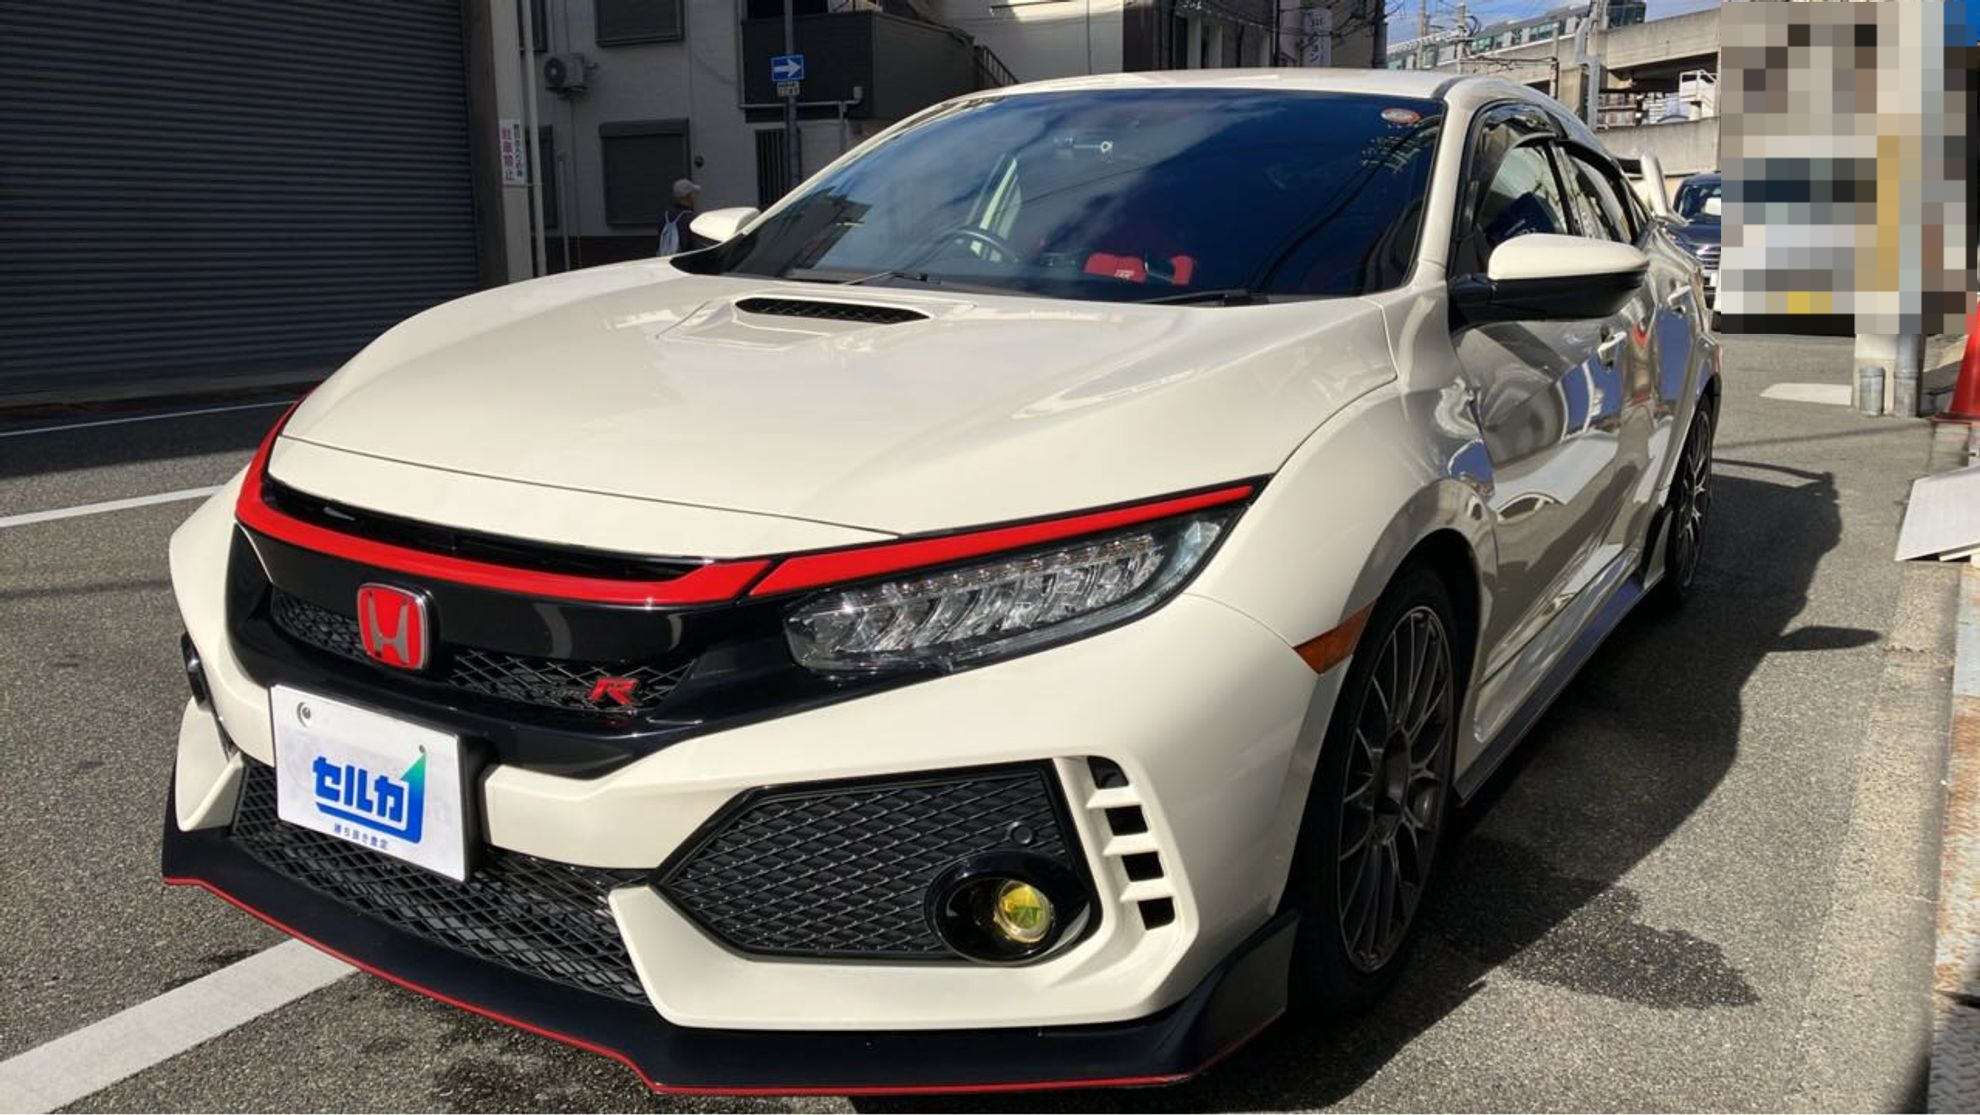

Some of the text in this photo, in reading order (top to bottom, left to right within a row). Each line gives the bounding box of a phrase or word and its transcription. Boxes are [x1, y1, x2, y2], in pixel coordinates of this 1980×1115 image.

[588, 677, 637, 704] R
[312, 755, 405, 823] セルカ
